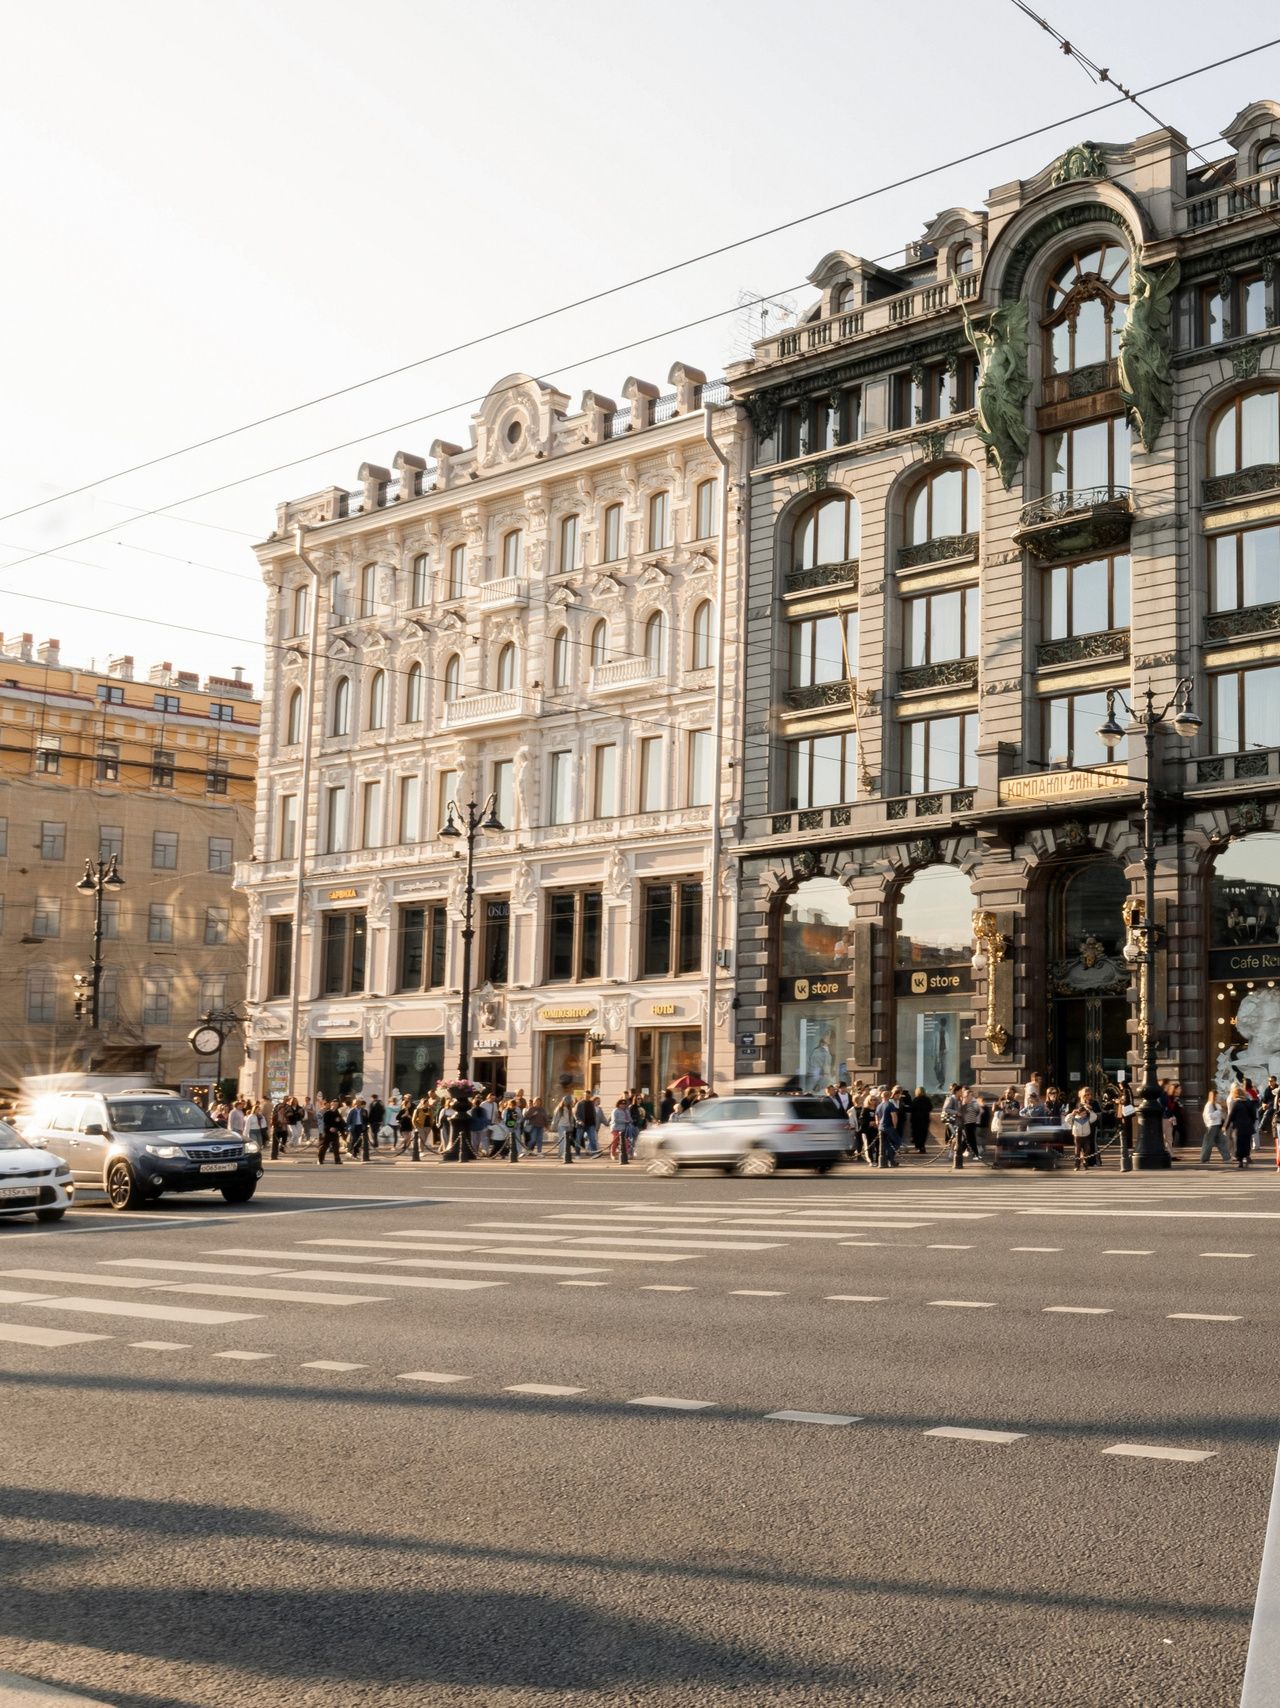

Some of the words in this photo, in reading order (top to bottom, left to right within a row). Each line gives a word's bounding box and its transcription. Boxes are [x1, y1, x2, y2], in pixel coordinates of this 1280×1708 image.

[1230, 955, 1260, 969] Cafe
[929, 974, 960, 988] store
[811, 982, 839, 995] store
[651, 1004, 675, 1015] НОТЫ
[473, 1039, 501, 1048] KEMPF
